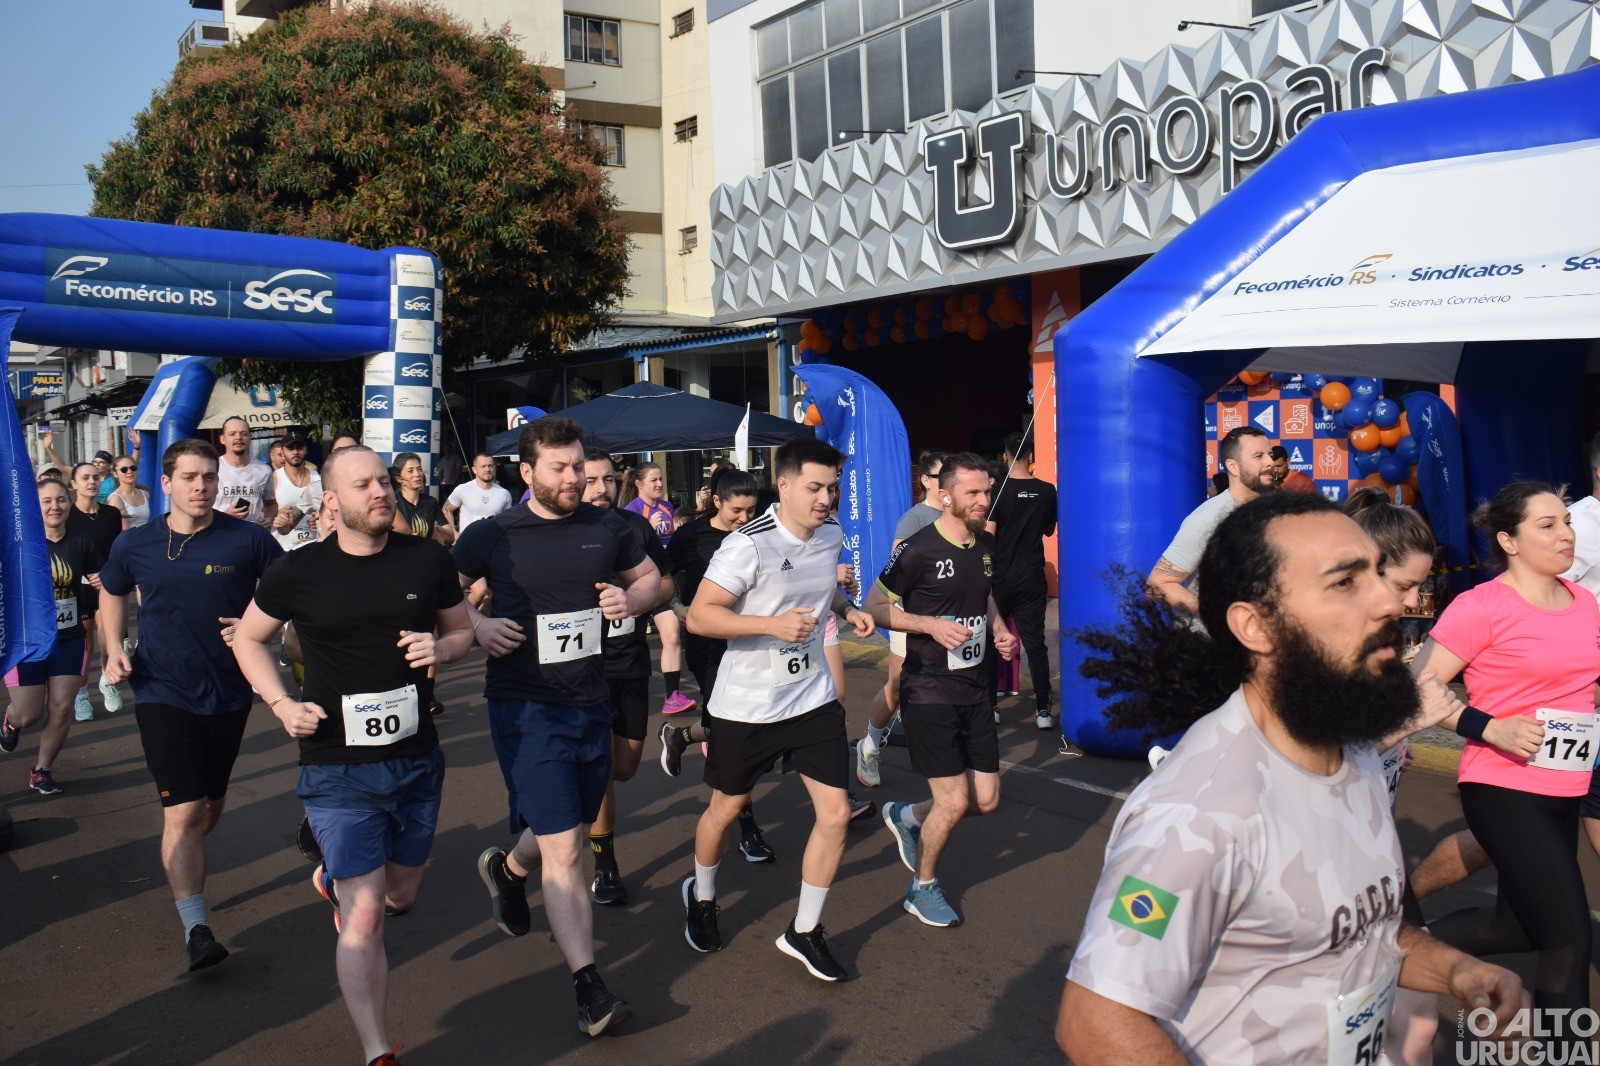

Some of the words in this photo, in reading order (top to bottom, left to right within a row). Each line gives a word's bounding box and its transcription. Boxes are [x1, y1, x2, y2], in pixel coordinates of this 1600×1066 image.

[1045, 46, 1390, 200] unopar
[1233, 273, 1344, 296] Fecomércio
[1348, 269, 1378, 286] RS
[1407, 263, 1525, 282] Sindicatos
[65, 279, 184, 304] Fecomércio
[190, 288, 217, 307] RS
[243, 280, 333, 314] Sesc
[1388, 297, 1443, 308] Sistema
[1447, 294, 1512, 306] Comércio
[403, 299, 431, 312] Sesc
[401, 366, 429, 378] Sesc
[365, 399, 389, 410] Sesc
[399, 433, 427, 444] Sesc
[12, 469, 20, 507] Comércio
[849, 470, 858, 520] Sindicatos
[14, 508, 22, 541] Sistema
[297, 532, 310, 540] 62
[851, 534, 860, 548] RS
[936, 558, 955, 579] 23
[548, 622, 571, 631] Sesc
[556, 632, 584, 653] 71
[779, 645, 800, 655] Sesc
[962, 642, 981, 661] 60
[787, 653, 809, 675] 61
[355, 703, 382, 713] Sesc
[365, 714, 400, 737] 80
[1547, 720, 1574, 732] Sesc
[1545, 736, 1590, 762] 174
[1345, 1002, 1375, 1035] Sesc
